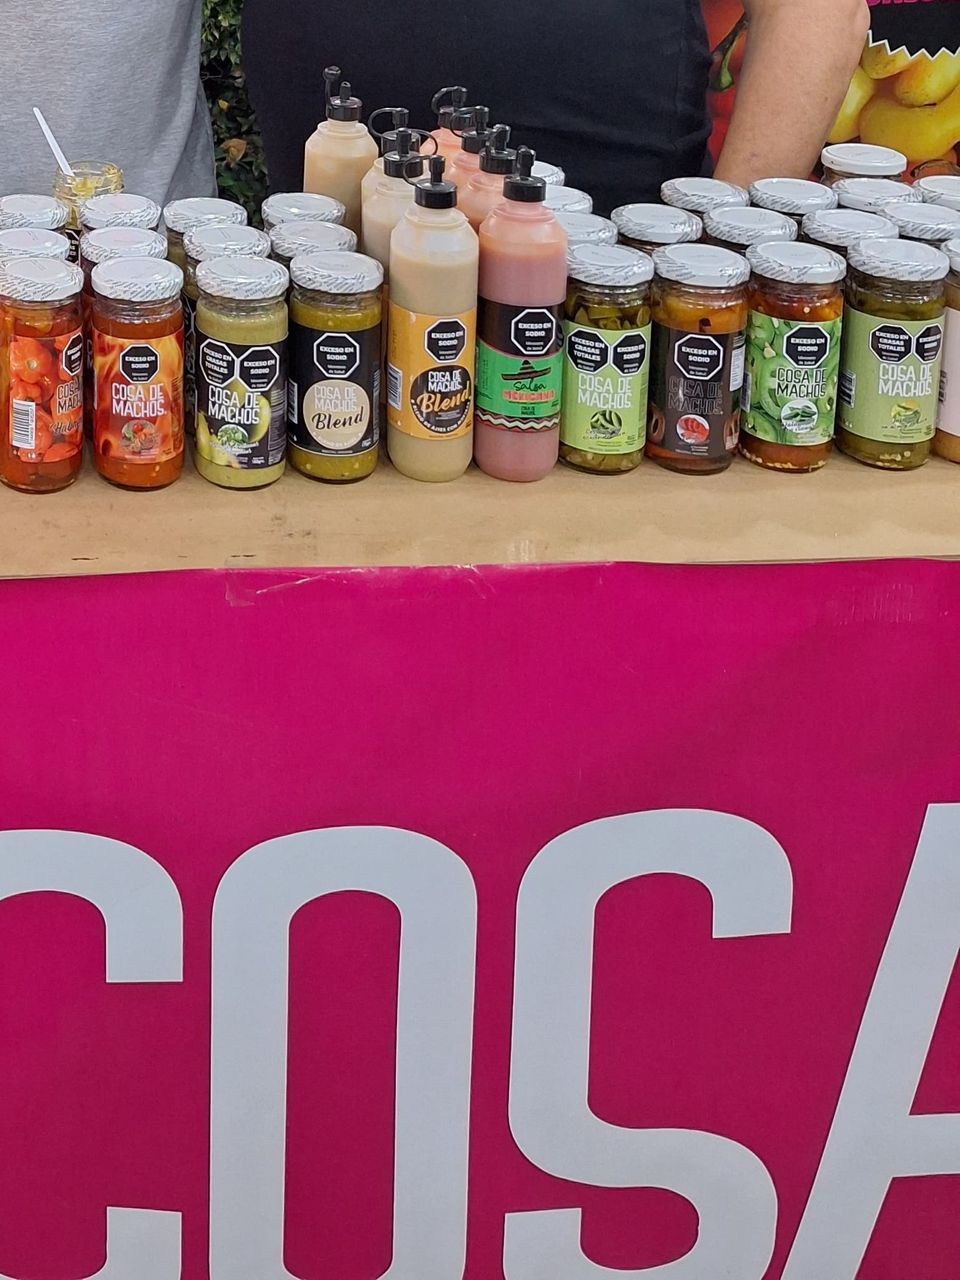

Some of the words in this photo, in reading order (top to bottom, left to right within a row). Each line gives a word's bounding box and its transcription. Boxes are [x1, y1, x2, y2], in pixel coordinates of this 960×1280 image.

[681, 346, 707, 355] EXCESO
[428, 371, 451, 382] COSA
[777, 367, 810, 383] COSA
[815, 368, 827, 383] DE
[879, 363, 916, 381] COSA
[920, 364, 933, 380] DE
[111, 382, 146, 402] COSA
[149, 383, 165, 401] DE
[314, 385, 341, 399] COSA
[578, 373, 613, 393] COSA
[617, 377, 633, 393] DE
[208, 385, 241, 408] COSA
[245, 392, 262, 409] DE
[416, 380, 470, 413] Blend
[311, 406, 364, 430] Blend
